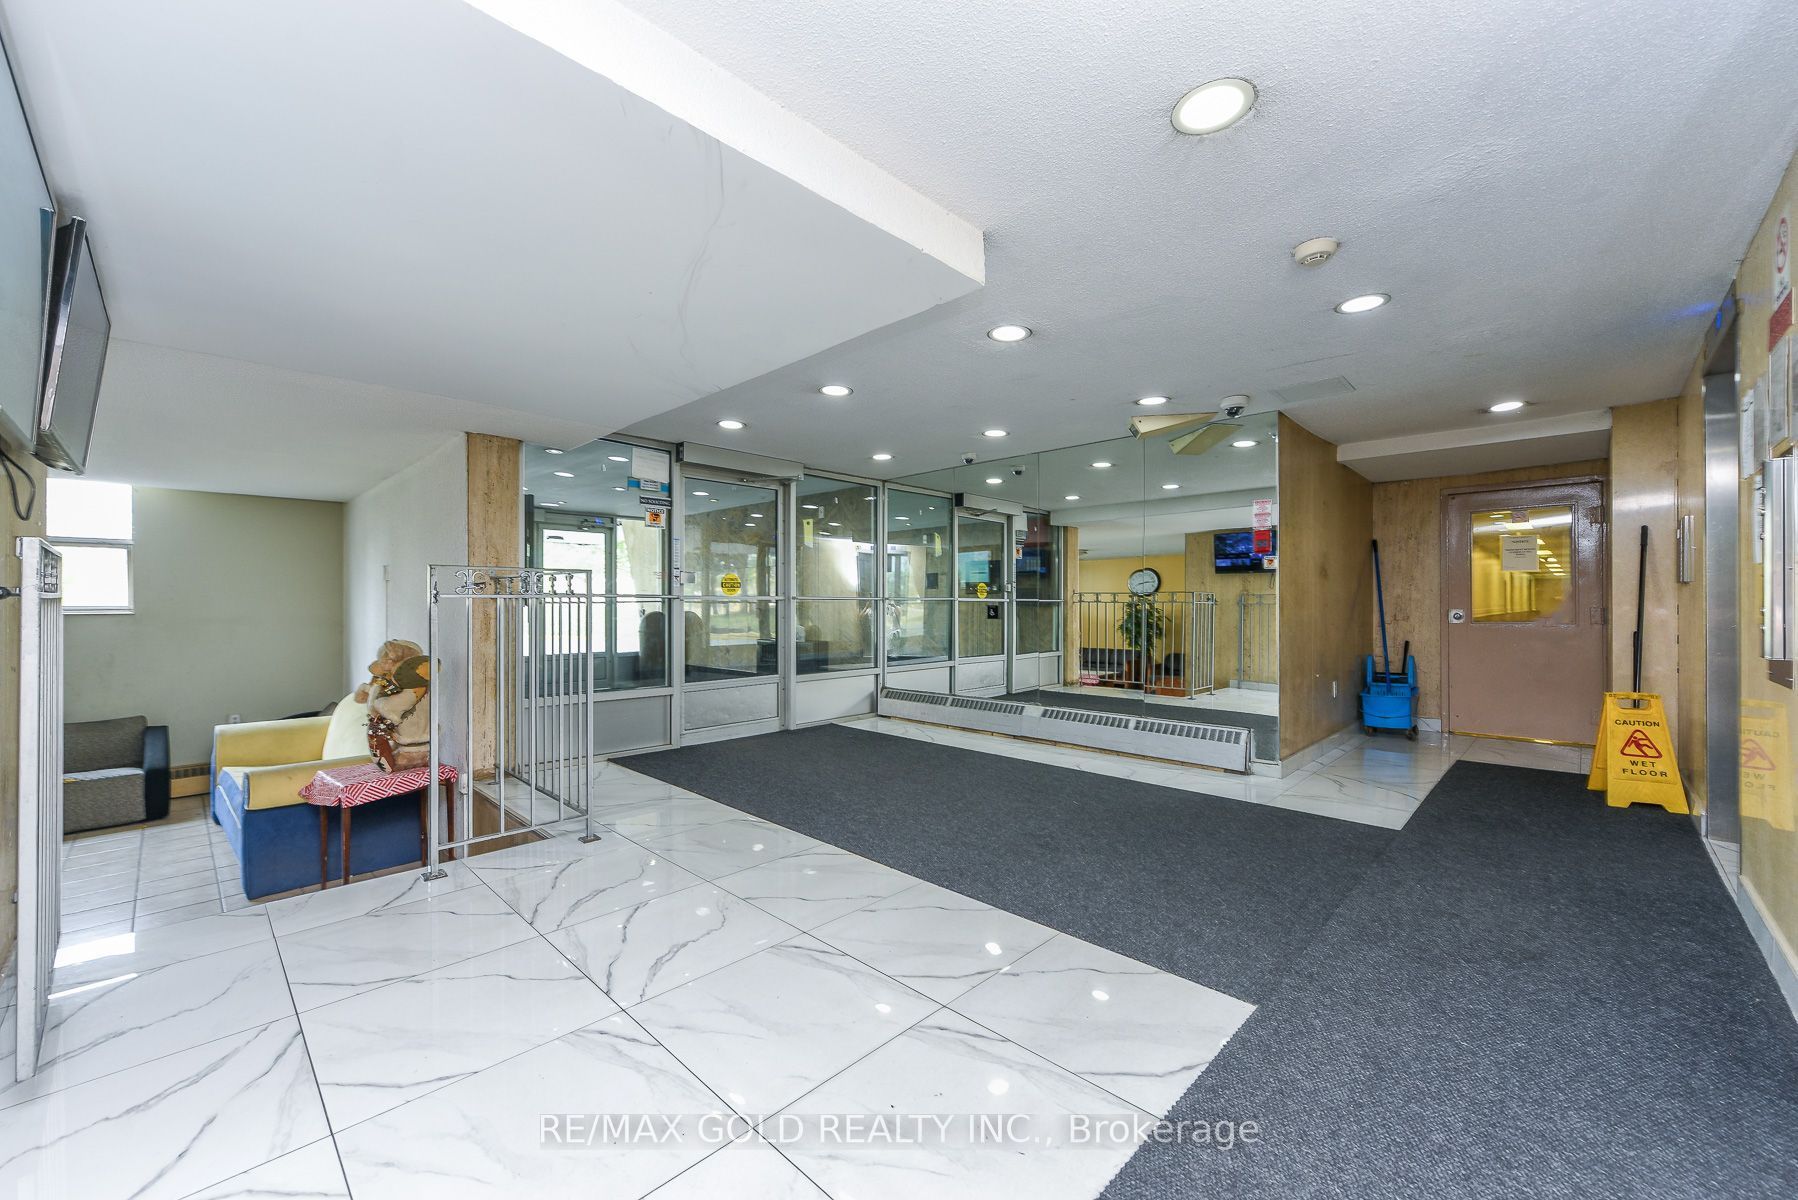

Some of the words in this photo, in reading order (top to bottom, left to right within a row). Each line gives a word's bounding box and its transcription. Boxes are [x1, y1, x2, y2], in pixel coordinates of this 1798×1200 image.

[1614, 719, 1660, 727] CAUTION
[1629, 760, 1656, 768] WET
[1622, 768, 1668, 778] FLOOR
